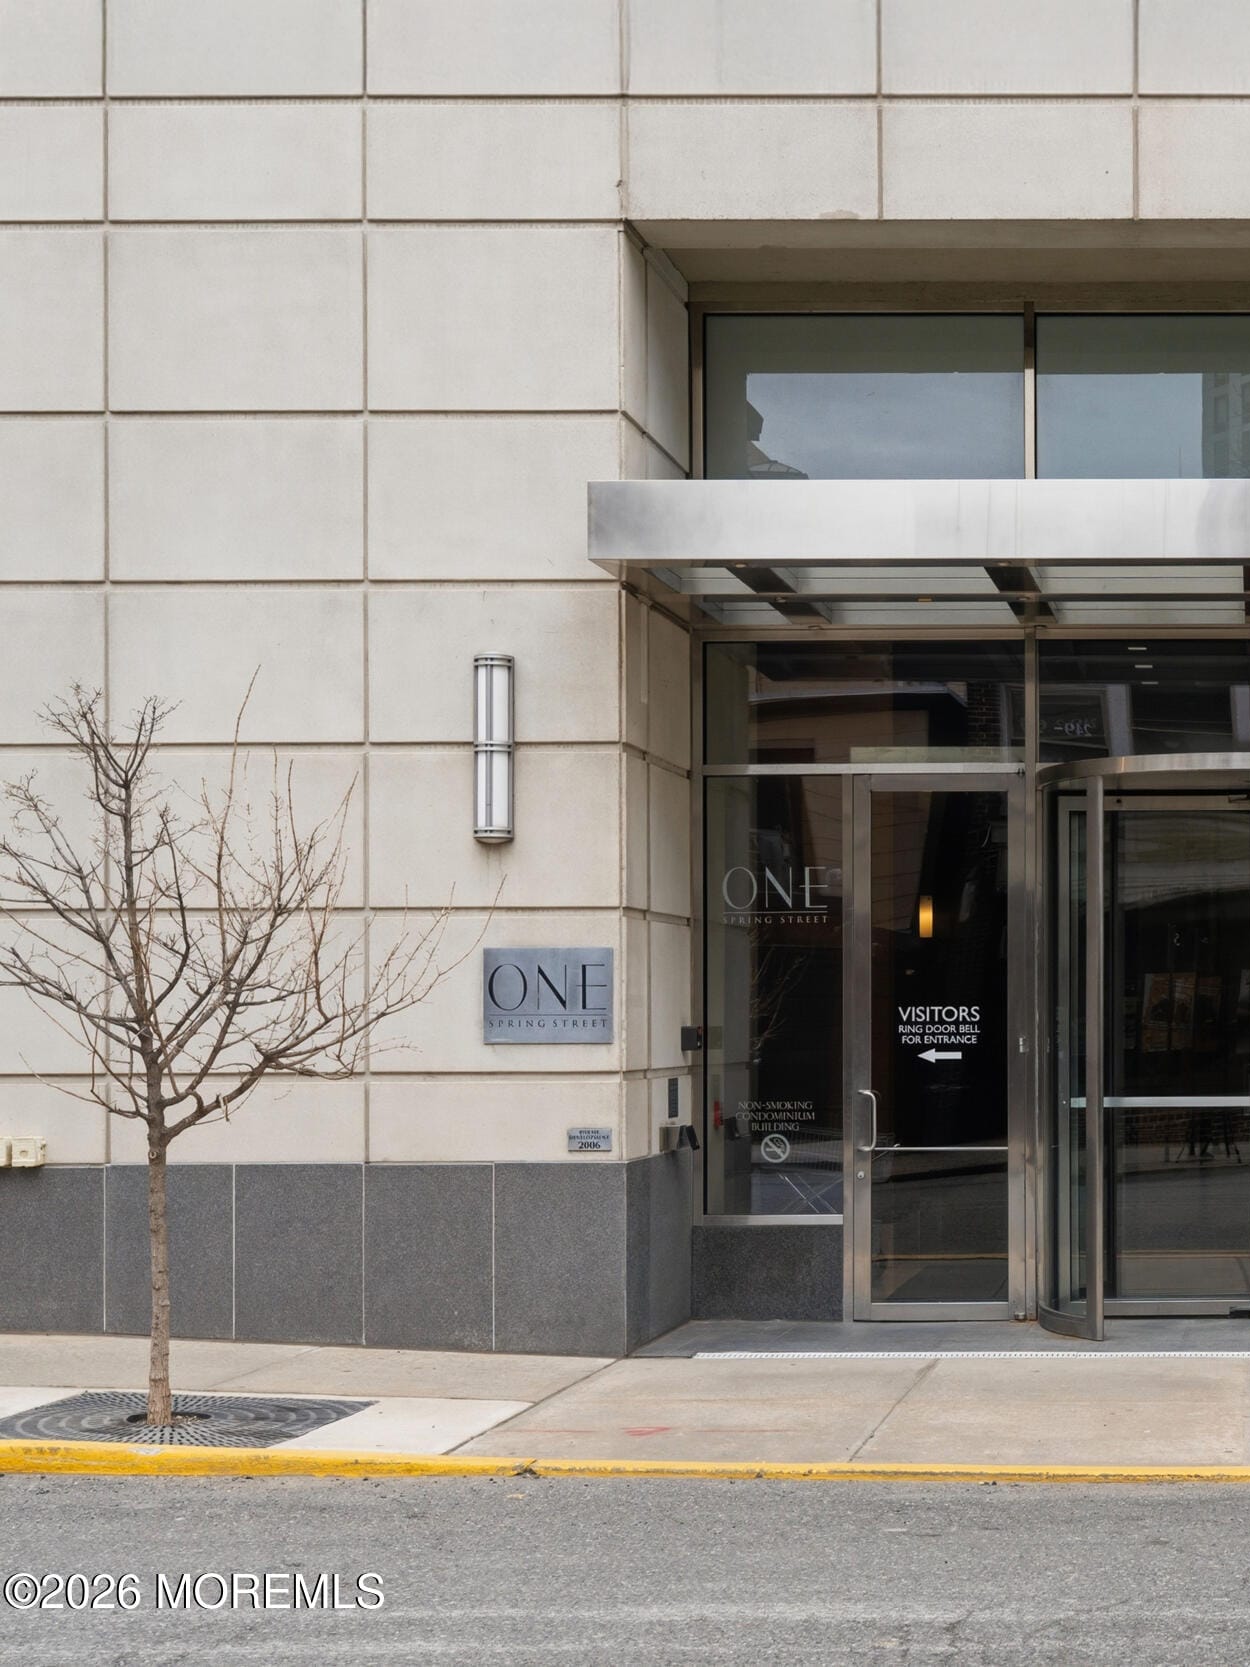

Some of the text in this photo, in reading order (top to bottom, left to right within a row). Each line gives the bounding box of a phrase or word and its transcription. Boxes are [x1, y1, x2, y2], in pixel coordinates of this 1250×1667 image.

[722, 866, 829, 910] ONE
[723, 915, 828, 924] SPRING STREET
[488, 963, 608, 1012] ONE
[898, 1006, 981, 1022] VISITORS
[488, 1018, 608, 1029] SPRING STREET
[898, 1024, 981, 1034] RING DOOR BELL
[901, 1035, 978, 1045] FOR ENTRANCE
[738, 1100, 814, 1110] NON-SMOKING
[735, 1111, 816, 1121] CONDOMINIUM
[751, 1121, 800, 1132] BUILDING
[577, 1140, 601, 1150] 2006
